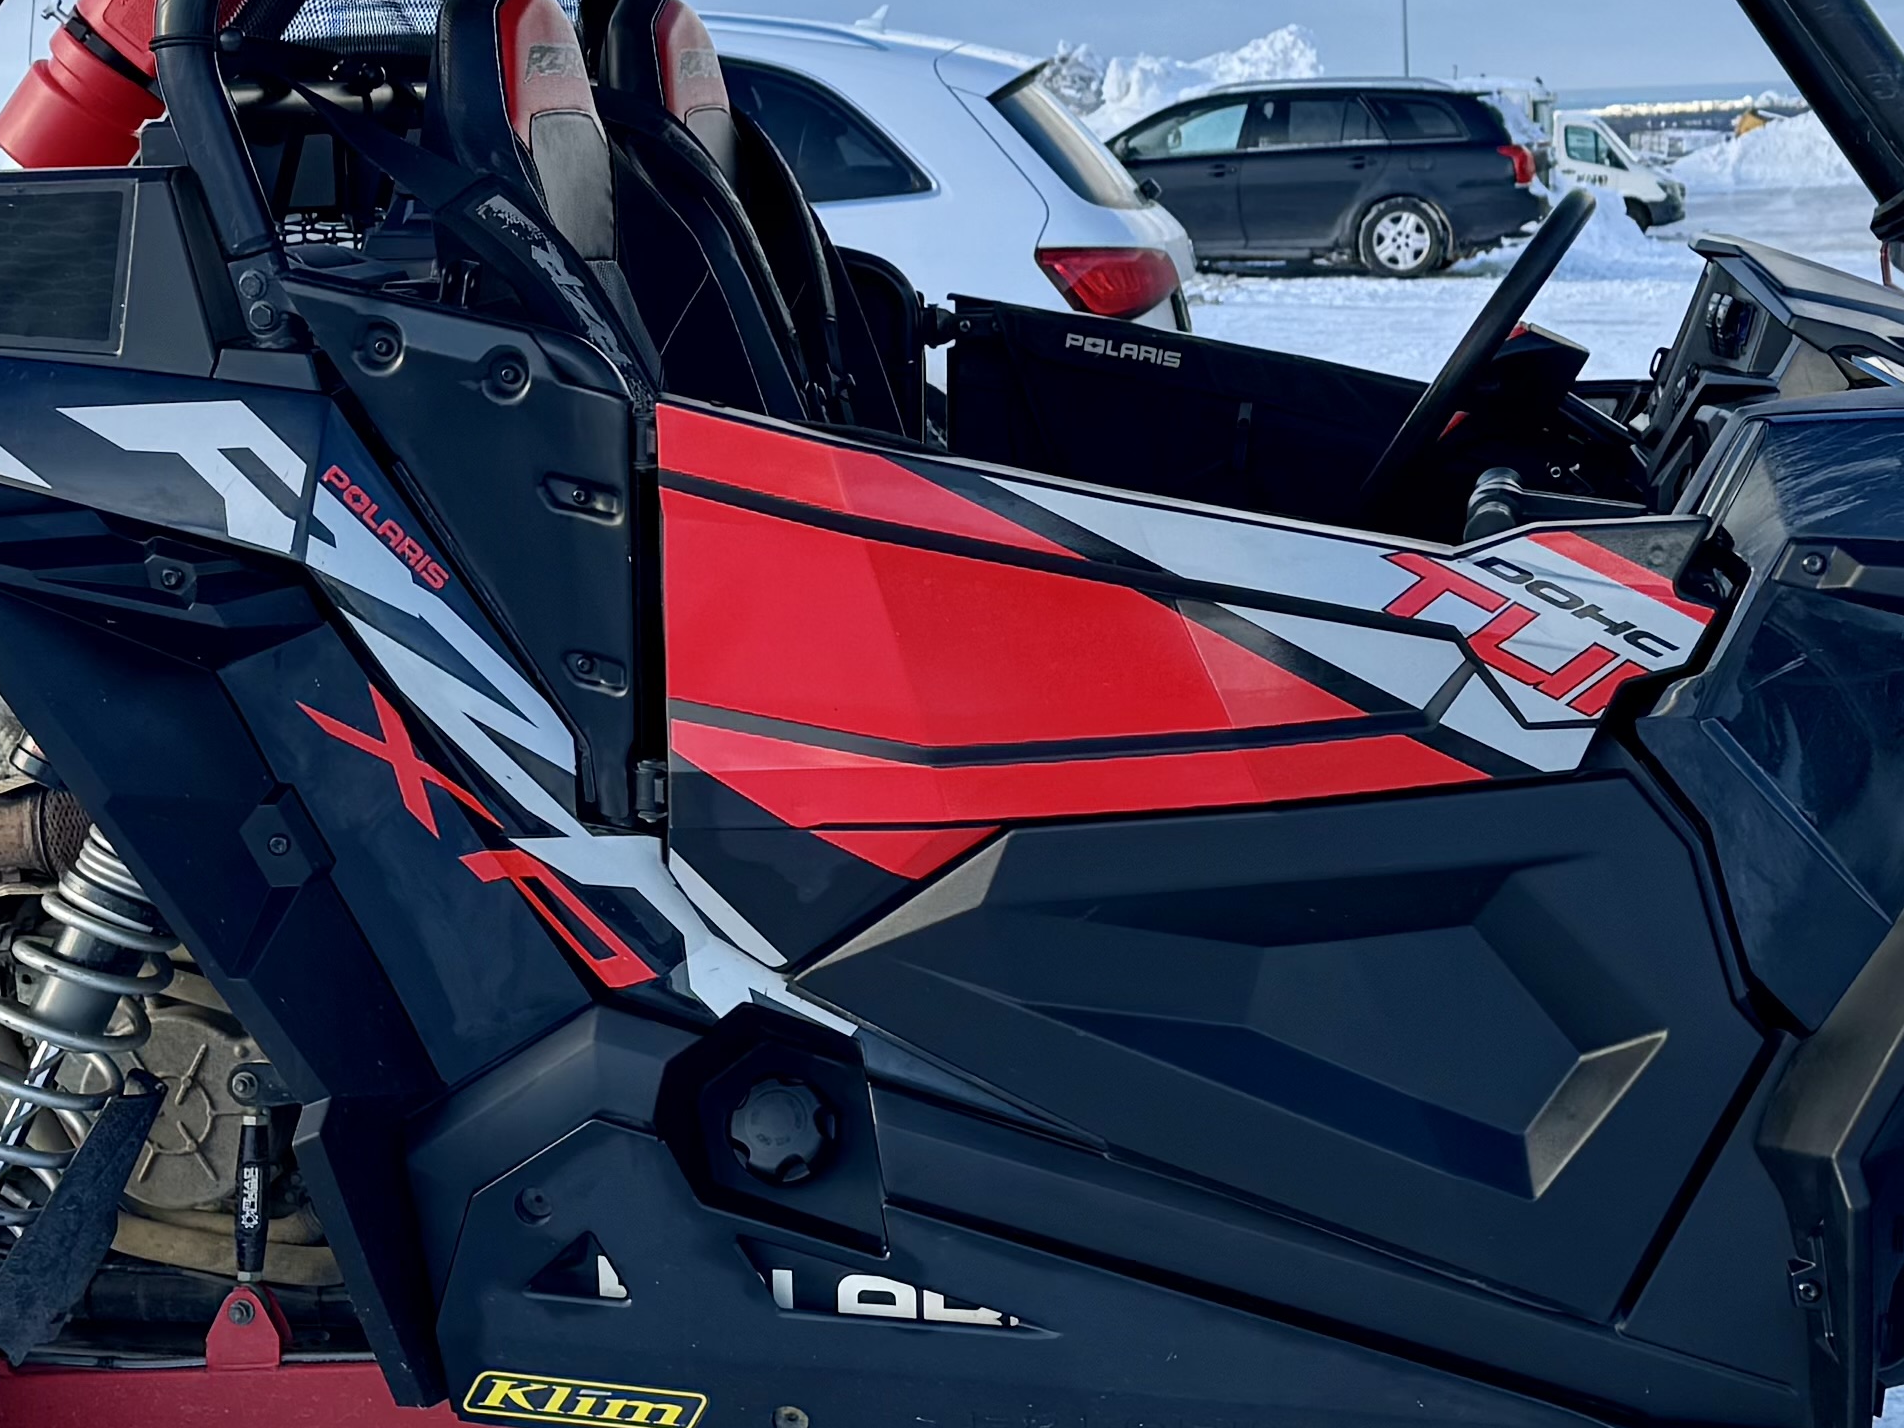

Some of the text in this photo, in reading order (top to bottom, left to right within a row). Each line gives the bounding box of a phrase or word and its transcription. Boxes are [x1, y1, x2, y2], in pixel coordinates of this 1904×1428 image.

[1065, 333, 1182, 368] POLARIS
[322, 465, 450, 590] POLARIS
[1472, 556, 1680, 658] DOHC
[478, 1378, 688, 1428] Klim
